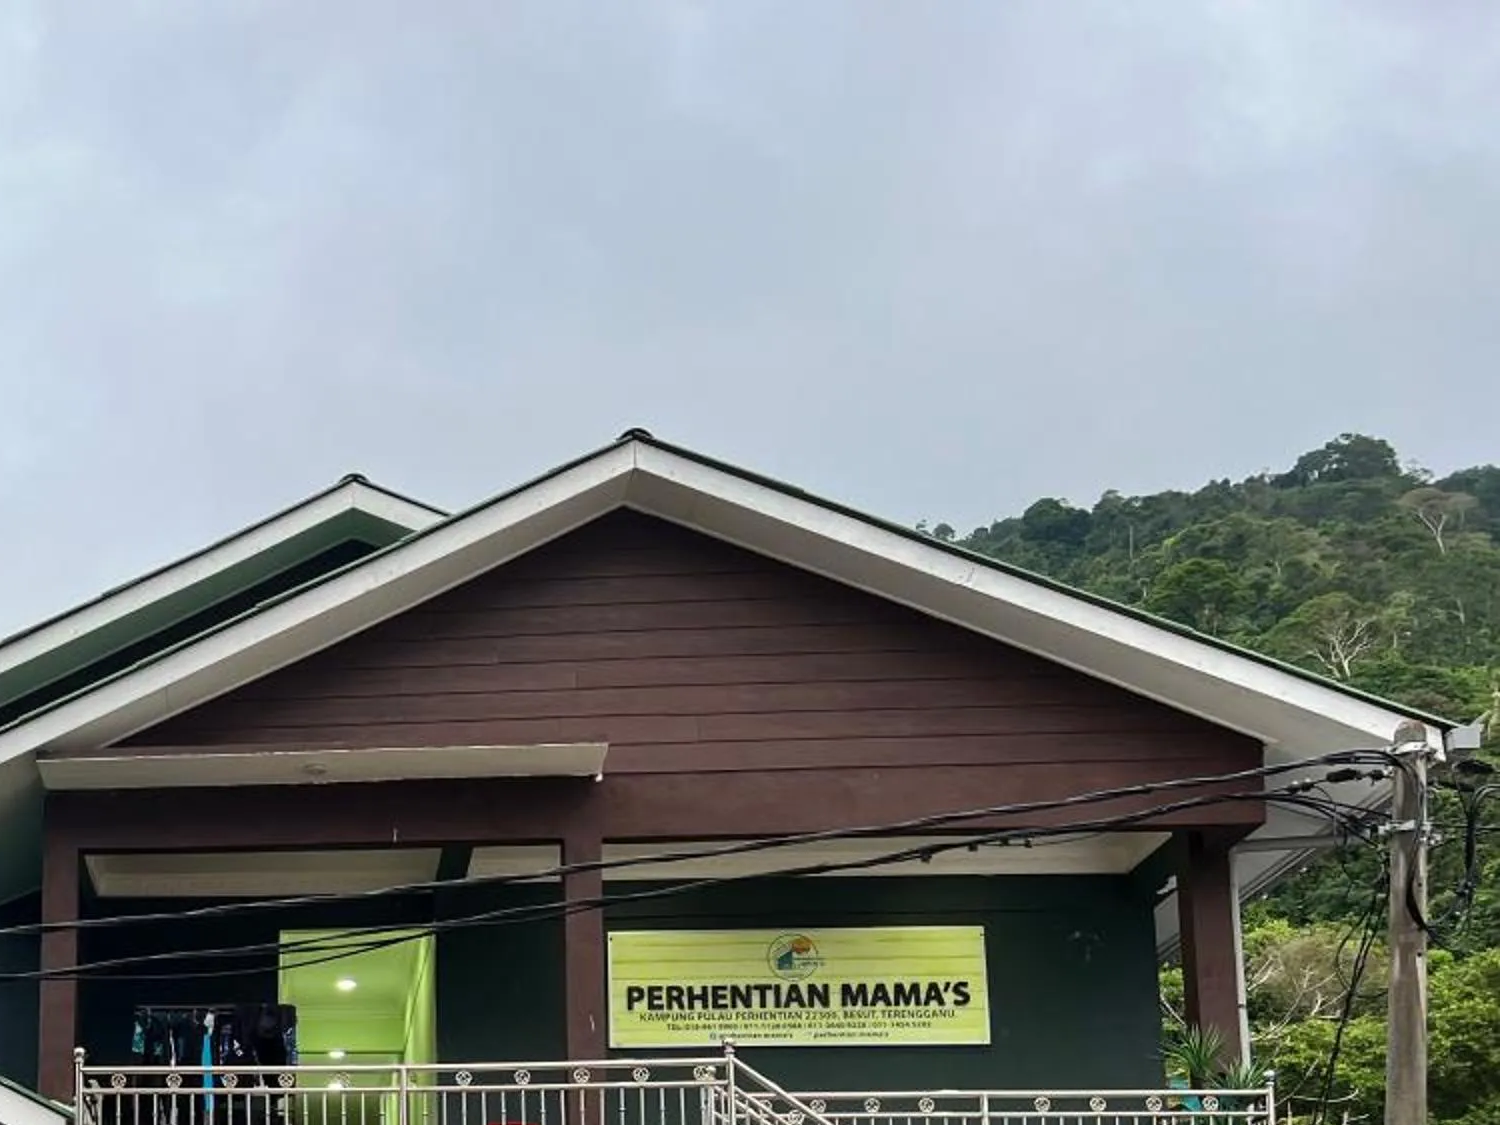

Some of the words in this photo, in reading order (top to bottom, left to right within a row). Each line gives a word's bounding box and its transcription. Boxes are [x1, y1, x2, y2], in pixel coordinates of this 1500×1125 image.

[626, 983, 830, 1011] PERHENTIAN
[840, 981, 971, 1008] MAMA'S
[640, 1013, 695, 1022] KAMPUNG
[699, 1012, 733, 1021] PULAU
[735, 1011, 802, 1021] PERHENTIAN
